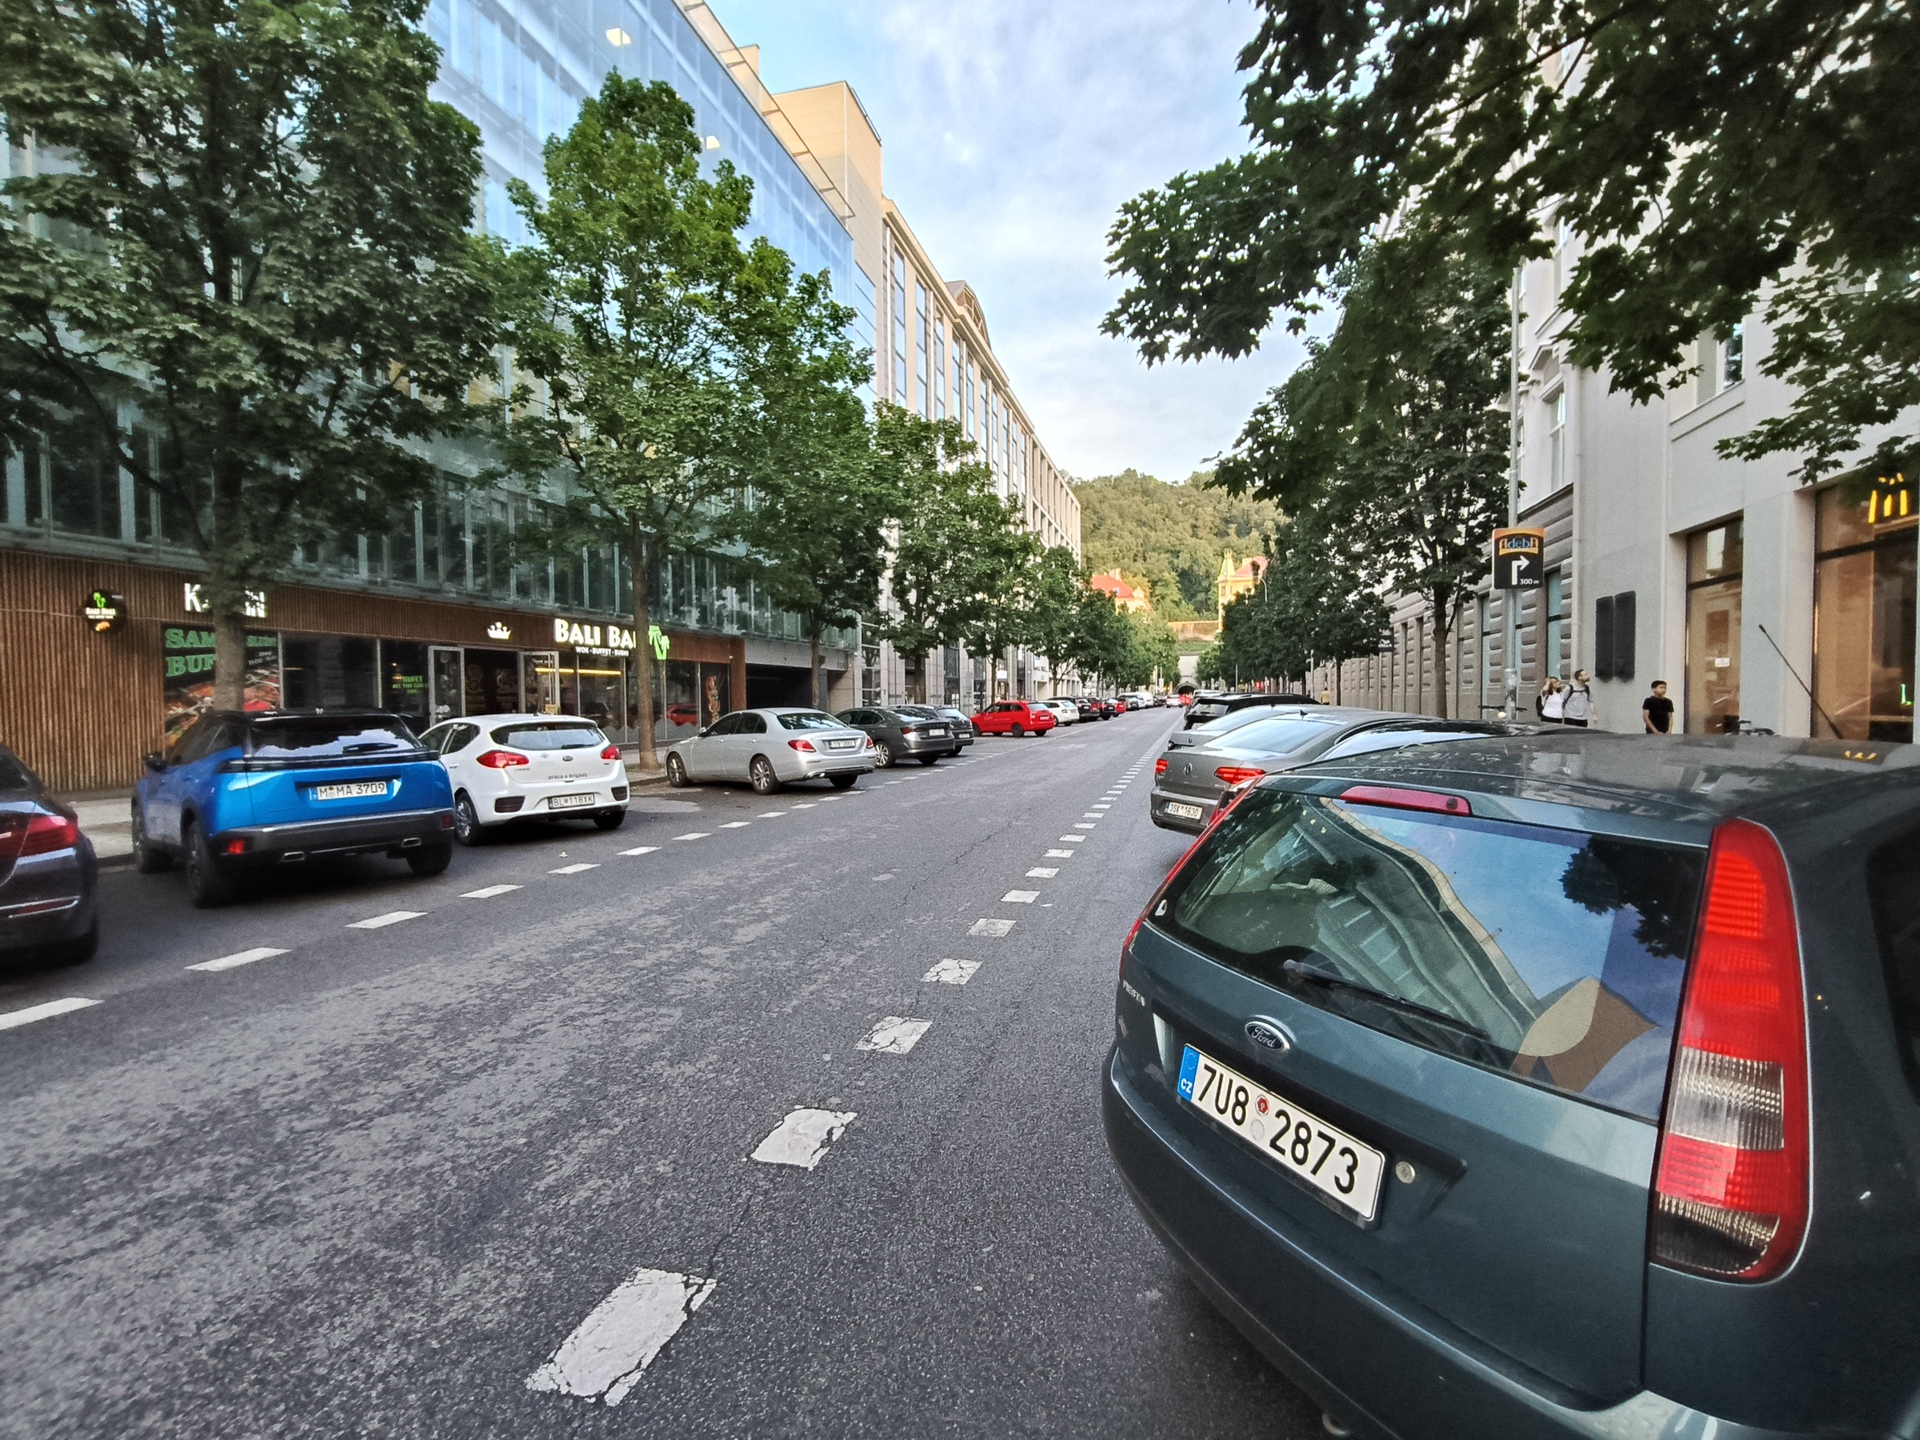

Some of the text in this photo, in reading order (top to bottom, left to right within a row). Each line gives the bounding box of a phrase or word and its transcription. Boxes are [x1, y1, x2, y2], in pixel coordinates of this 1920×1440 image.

[553, 618, 601, 647] BALI
[575, 646, 590, 654] WOK
[592, 647, 612, 656] BUFFET
[319, 782, 385, 798] M MA 3709
[1250, 1026, 1278, 1049] Ford
[1180, 1077, 1193, 1094] CZ
[1198, 1063, 1360, 1195] 7U8 2873
